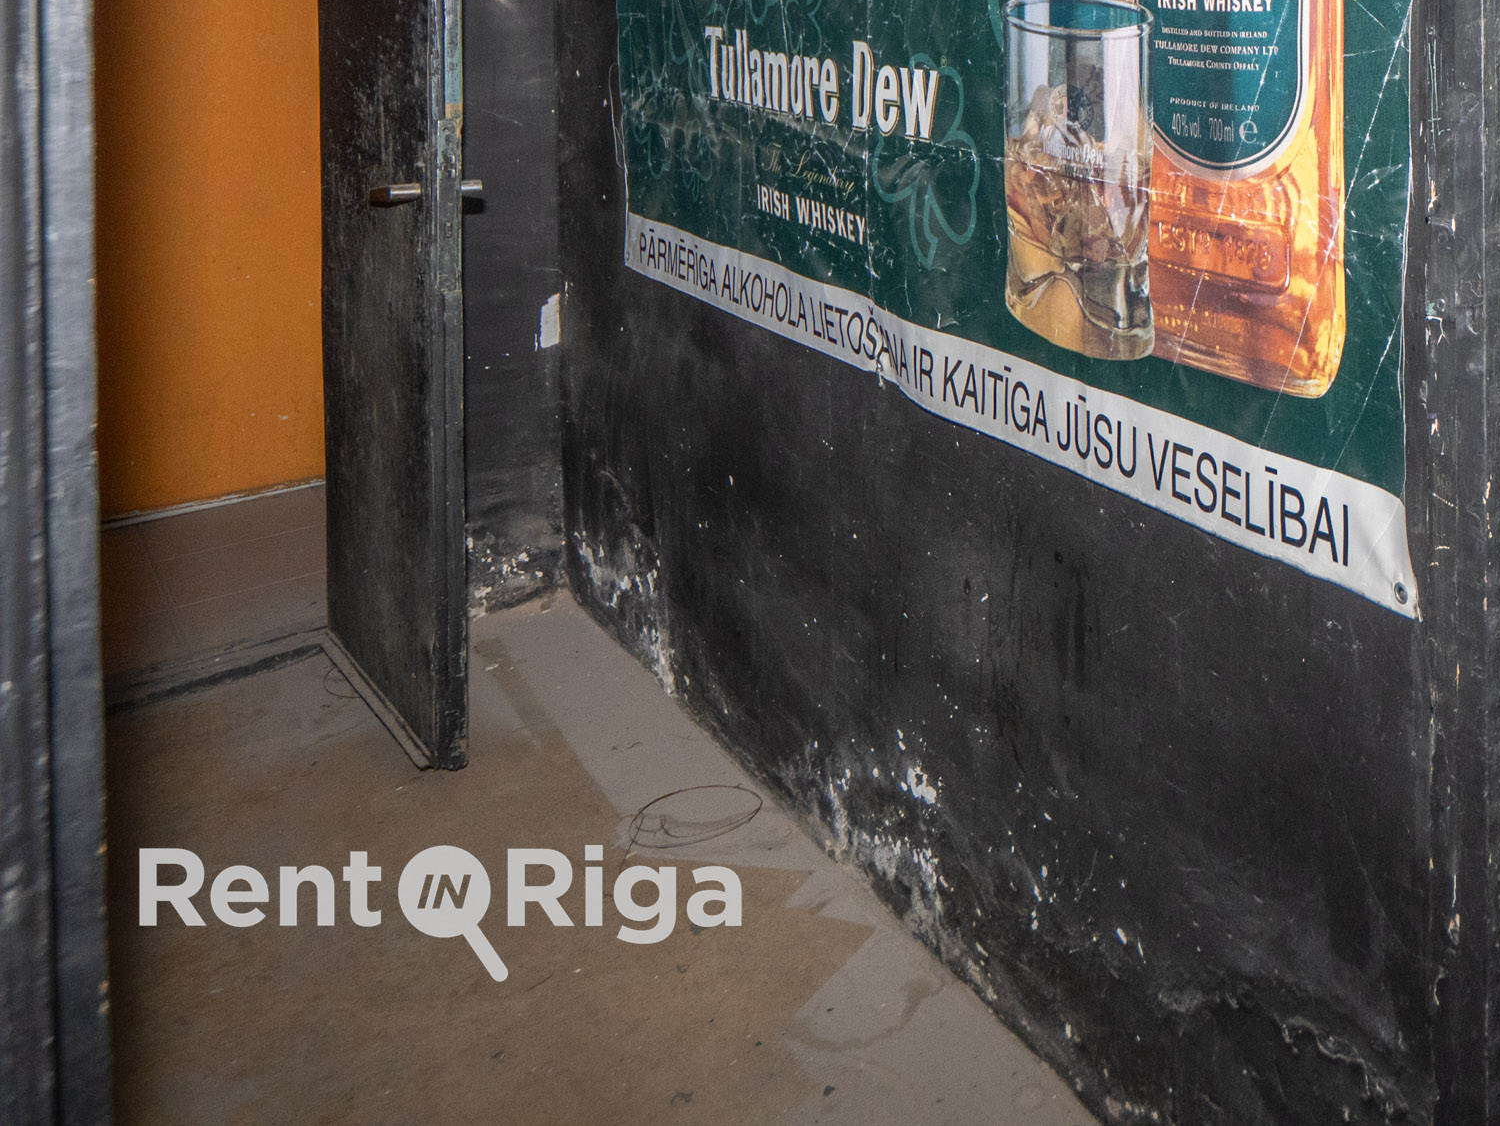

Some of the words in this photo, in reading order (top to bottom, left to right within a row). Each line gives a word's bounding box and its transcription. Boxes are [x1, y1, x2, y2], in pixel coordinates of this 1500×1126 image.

[1153, 39, 1199, 53] TULLAMORE
[1200, 44, 1219, 54] DEW
[1220, 45, 1260, 55] COMPANY
[1239, 31, 1268, 39] IRELAND
[704, 25, 840, 125] Tullamore
[852, 40, 939, 142] Dew
[1169, 96, 1207, 108] PRODUCT
[1209, 101, 1220, 110] OF
[1220, 103, 1260, 112] IRELAND
[757, 184, 790, 221] IRISH
[795, 195, 865, 246] WHISKEY
[639, 228, 718, 296] PĀRMĒRĪGA
[721, 264, 809, 333] ALKOHOLA
[912, 343, 935, 398] IR
[943, 354, 1050, 443] KAITĪGA
[1057, 395, 1138, 479] JŪSU
[1147, 432, 1351, 567] VESELĪBAI
